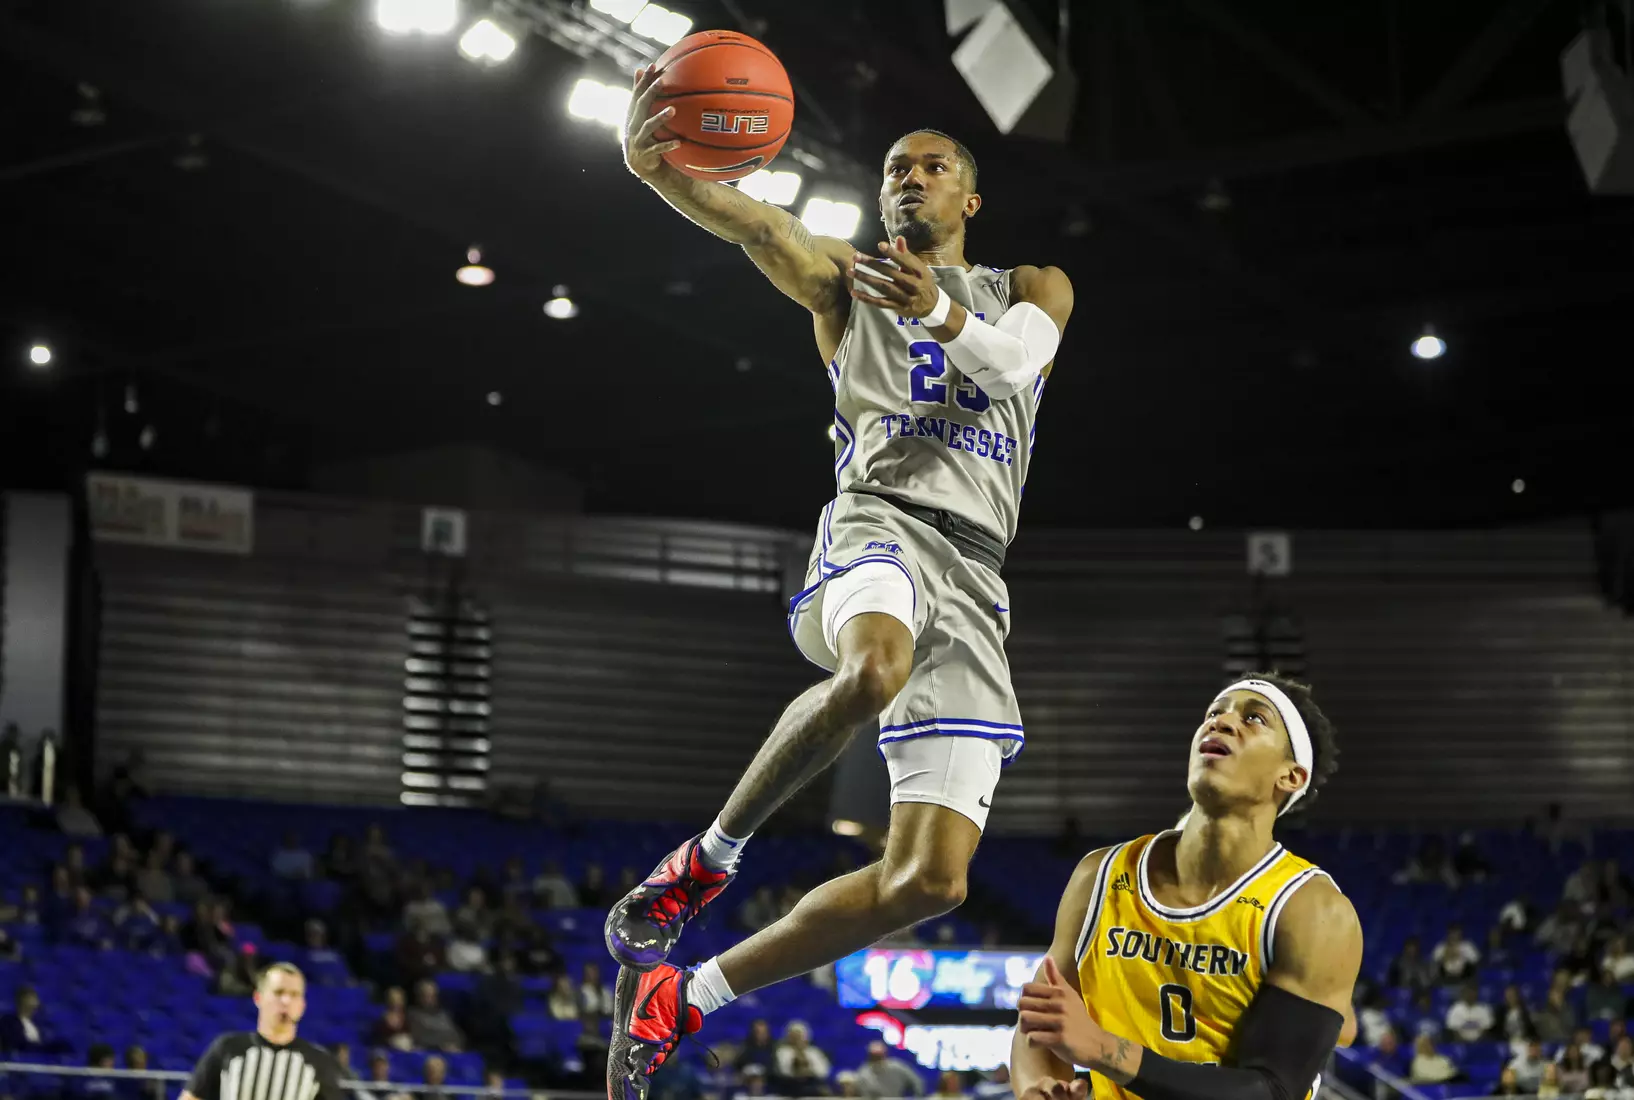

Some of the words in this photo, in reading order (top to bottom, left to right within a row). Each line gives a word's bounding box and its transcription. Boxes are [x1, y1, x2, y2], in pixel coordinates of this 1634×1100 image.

[701, 113, 769, 134] ELITE
[864, 955, 920, 1001] 16
[1159, 982, 1197, 1043] 0
